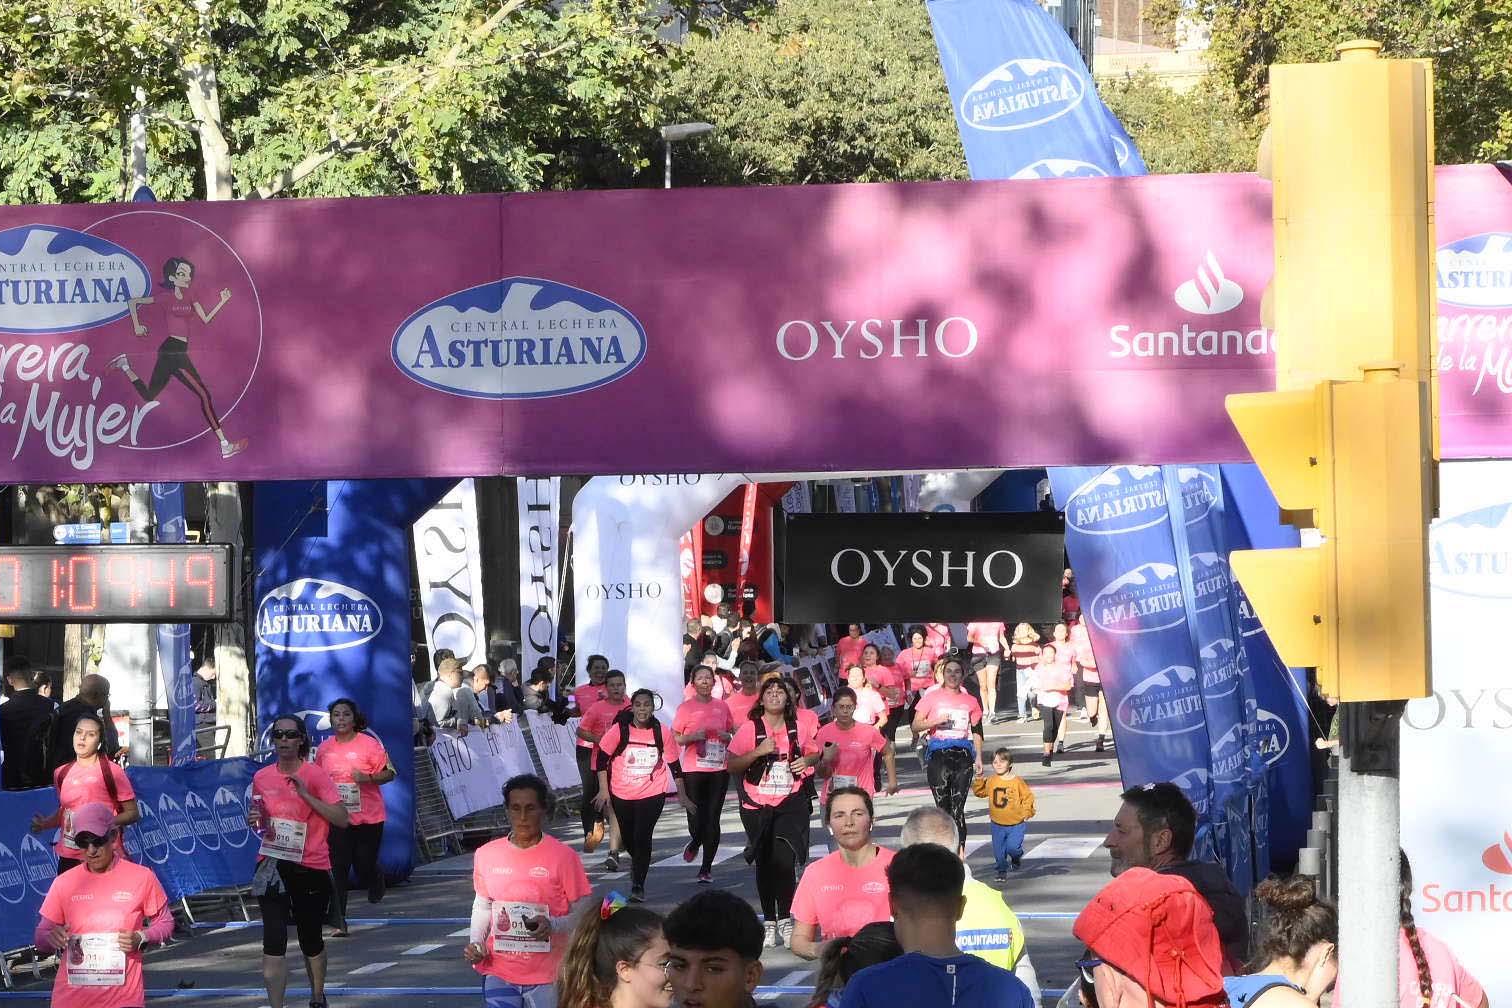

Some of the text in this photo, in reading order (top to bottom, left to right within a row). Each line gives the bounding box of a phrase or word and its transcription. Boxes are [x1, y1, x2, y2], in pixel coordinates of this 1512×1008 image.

[54, 261, 127, 272] LECHERA
[450, 318, 618, 333] CENTRAL LECHERA
[776, 316, 978, 361] OYSHO
[411, 325, 627, 368] ASTURIANA
[12, 376, 161, 471] Mujer
[830, 547, 1024, 589] OYSHO
[586, 582, 662, 600] OYSHO
[261, 607, 374, 636] ASTURIANA
